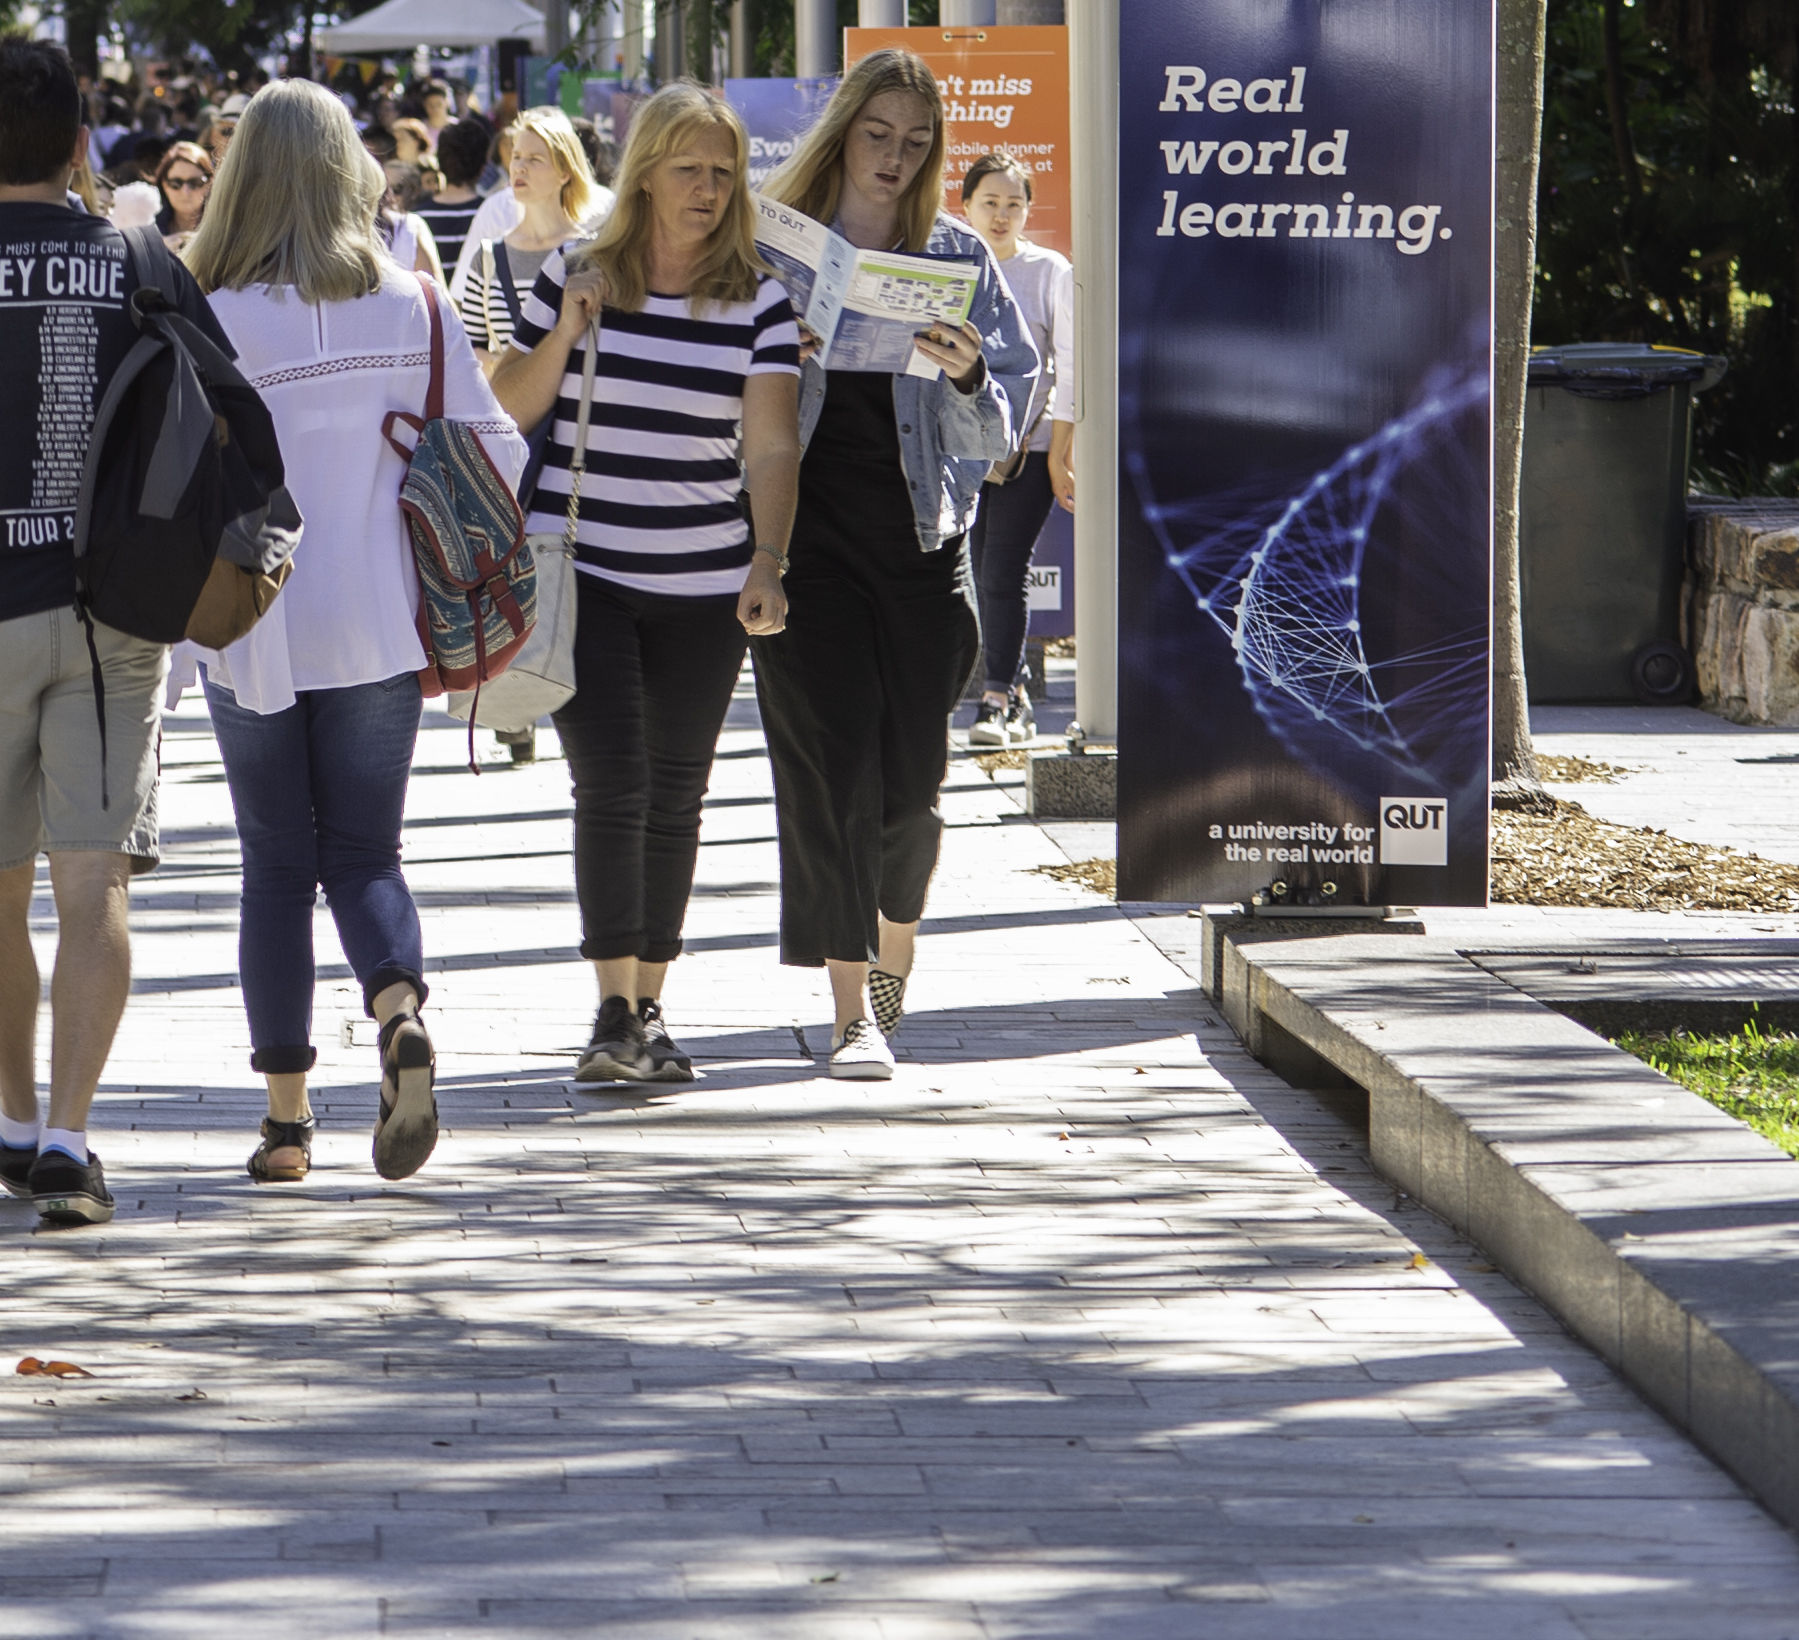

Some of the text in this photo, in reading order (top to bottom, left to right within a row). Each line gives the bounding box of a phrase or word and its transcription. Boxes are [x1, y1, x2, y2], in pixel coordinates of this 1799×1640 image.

[936, 74, 1032, 96] n't miss
[1158, 66, 1306, 113] Real
[1159, 129, 1349, 175] world
[1035, 160, 1053, 172] at
[760, 204, 776, 219] TO
[779, 215, 808, 233] QUT
[1156, 190, 1452, 255] learning.
[6, 242, 36, 256] MUST
[40, 240, 69, 255] COME
[74, 241, 86, 255] TO
[89, 243, 103, 256] AN
[105, 245, 126, 260] END
[46, 256, 125, 299] CRÜE
[5, 516, 59, 547] TOUR
[1384, 804, 1444, 830] QUT
[1208, 821, 1375, 845] a university for
[1224, 842, 1374, 864] the real world
